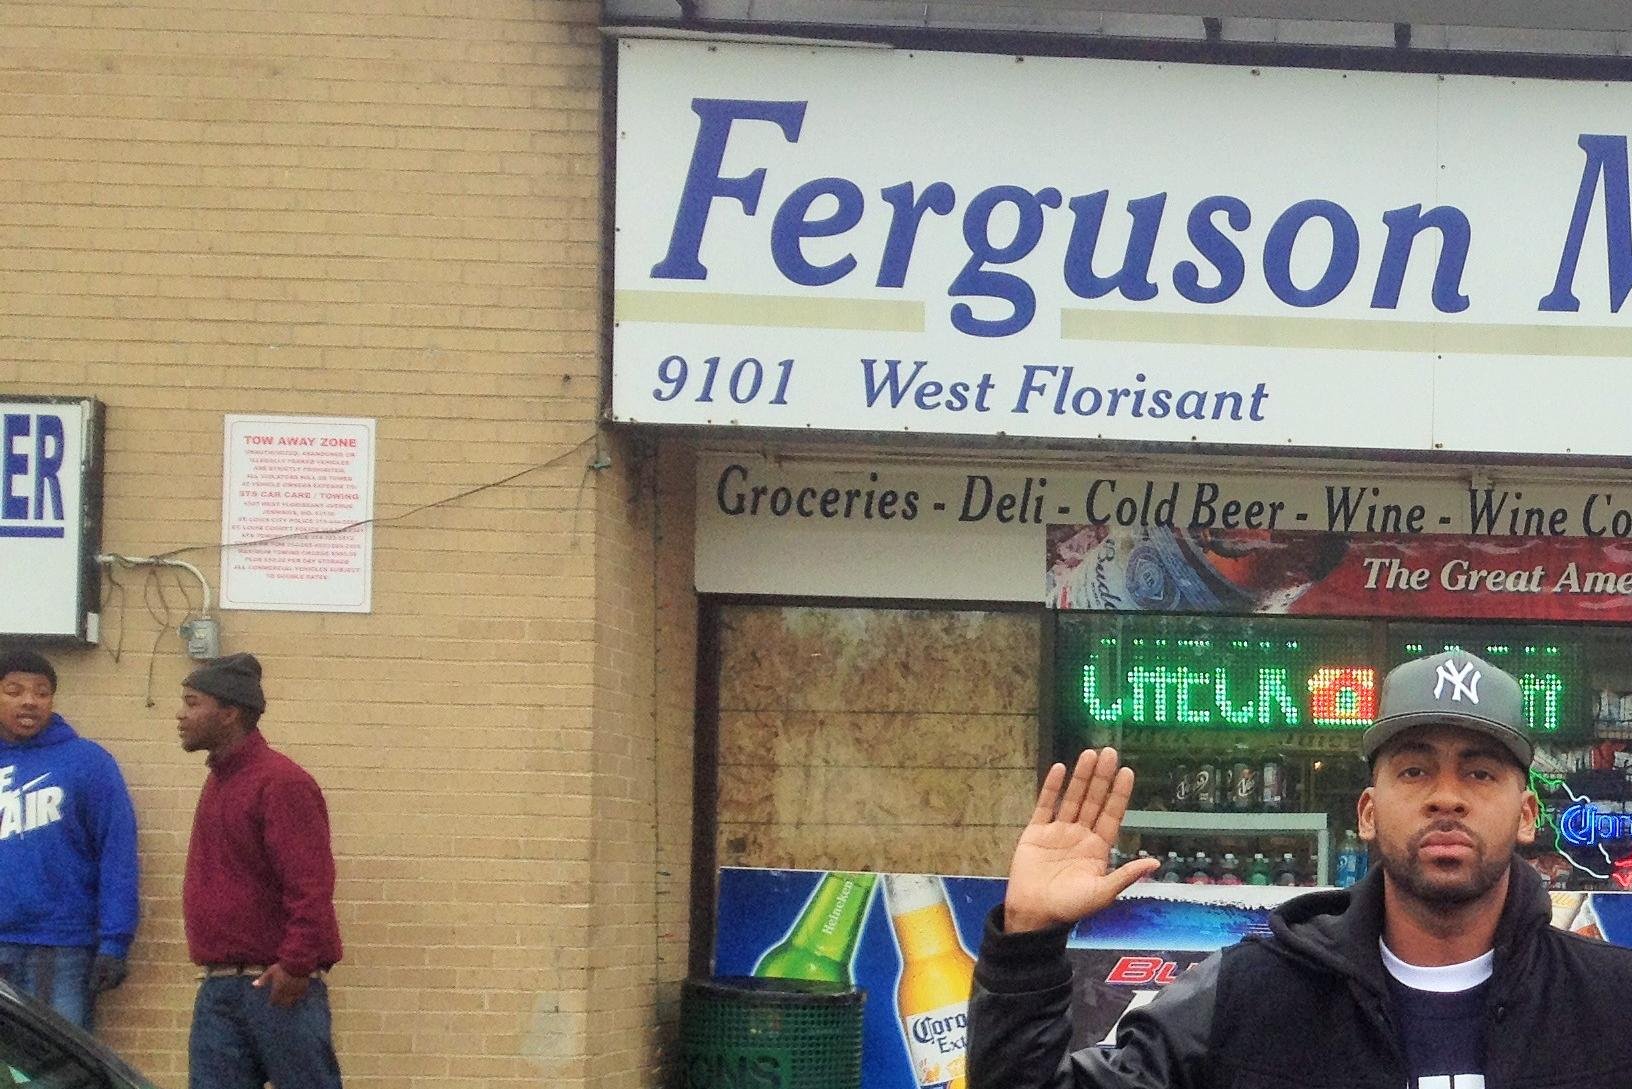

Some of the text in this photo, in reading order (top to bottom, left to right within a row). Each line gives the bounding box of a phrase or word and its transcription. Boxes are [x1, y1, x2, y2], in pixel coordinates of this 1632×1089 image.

[650, 97, 1472, 338] Ferguson
[653, 355, 1269, 423] 9101 West Florisant
[244, 435, 357, 448] TOW AWAY ZONE
[716, 464, 920, 521] Groceries
[958, 474, 1047, 525] Deli
[1085, 478, 1181, 529] Cold
[1188, 481, 1286, 530] Beer
[1325, 485, 1425, 534] Wine
[1468, 488, 1568, 537] Wine
[1363, 557, 1431, 592] The
[1440, 558, 1544, 594] Great
[821, 880, 854, 936] Heineken
